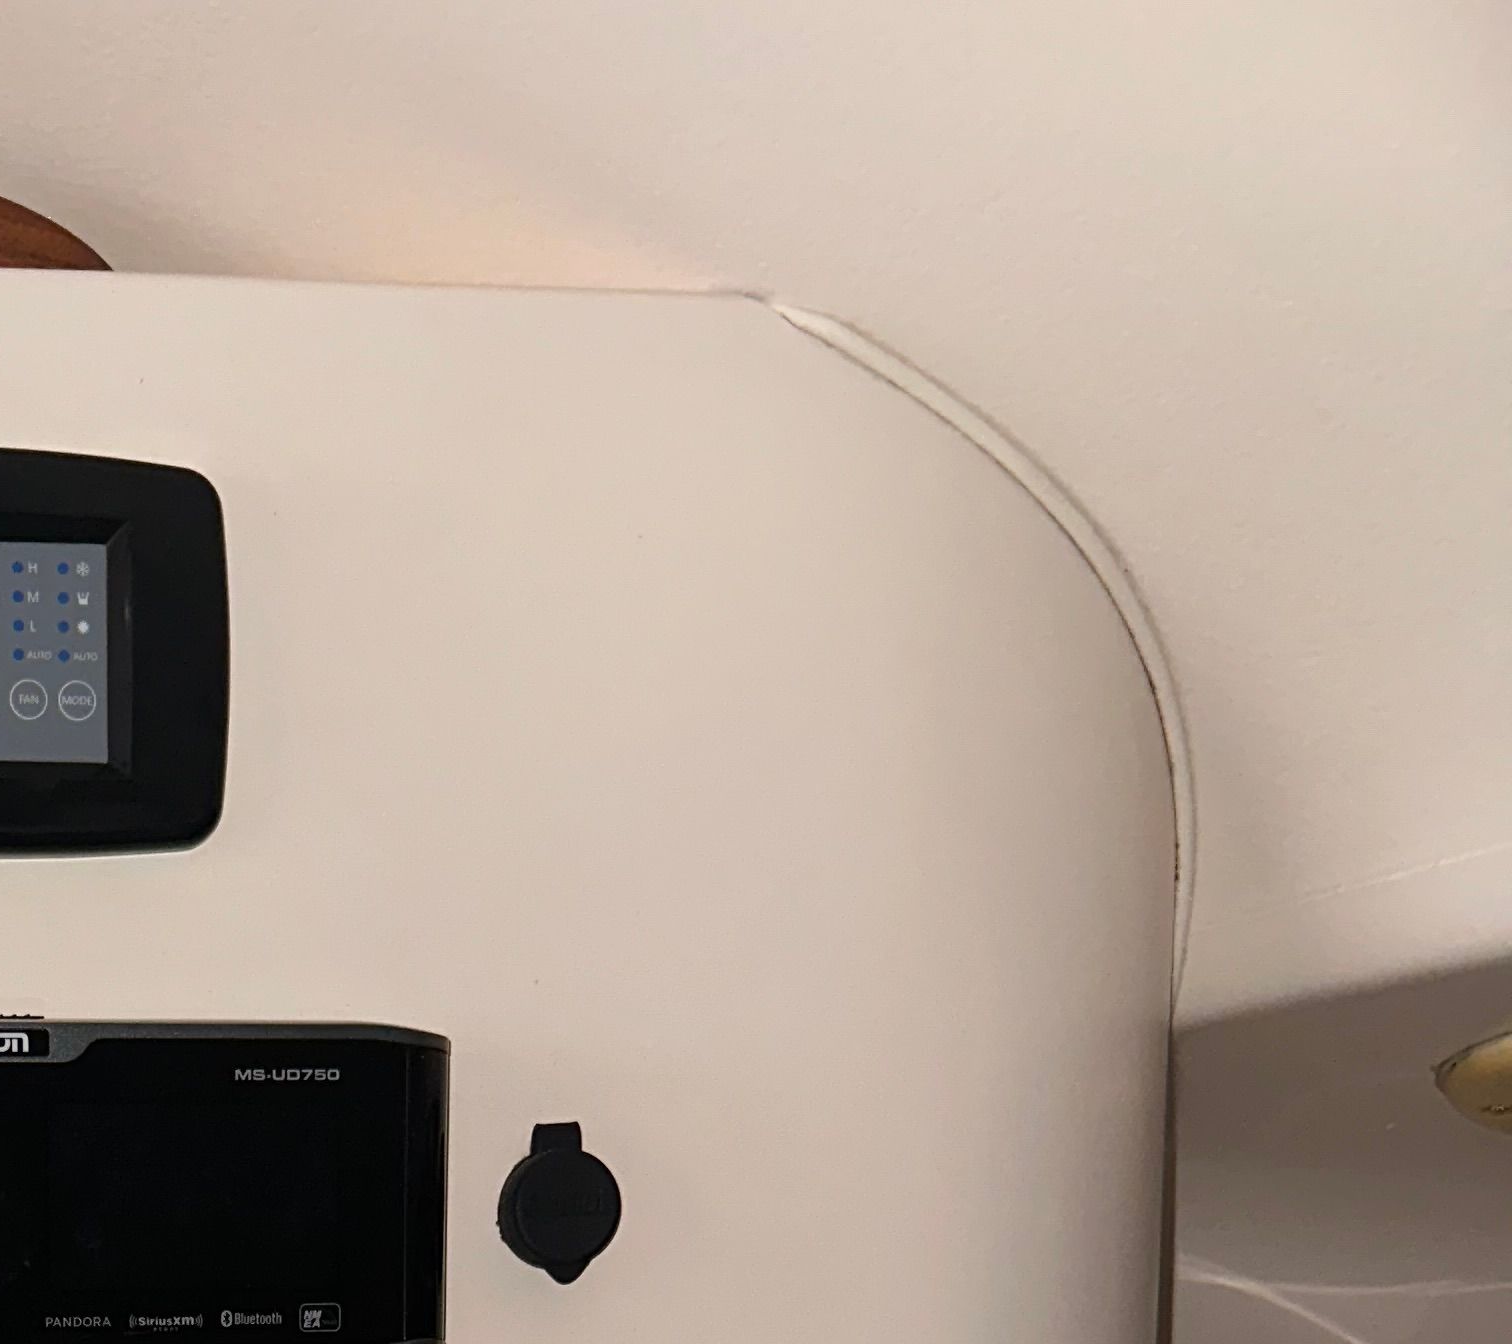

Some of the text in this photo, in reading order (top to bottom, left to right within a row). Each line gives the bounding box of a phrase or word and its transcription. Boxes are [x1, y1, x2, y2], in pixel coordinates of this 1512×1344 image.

[28, 562, 38, 574] H
[27, 591, 39, 603] M
[30, 619, 37, 632] L
[27, 650, 53, 660] AUTO
[73, 651, 98, 661] AUTO
[61, 695, 93, 706] MODE
[235, 1068, 340, 1080] MS-UD750
[45, 1316, 112, 1327] PANDORA
[234, 1311, 283, 1325] Bluetooth
